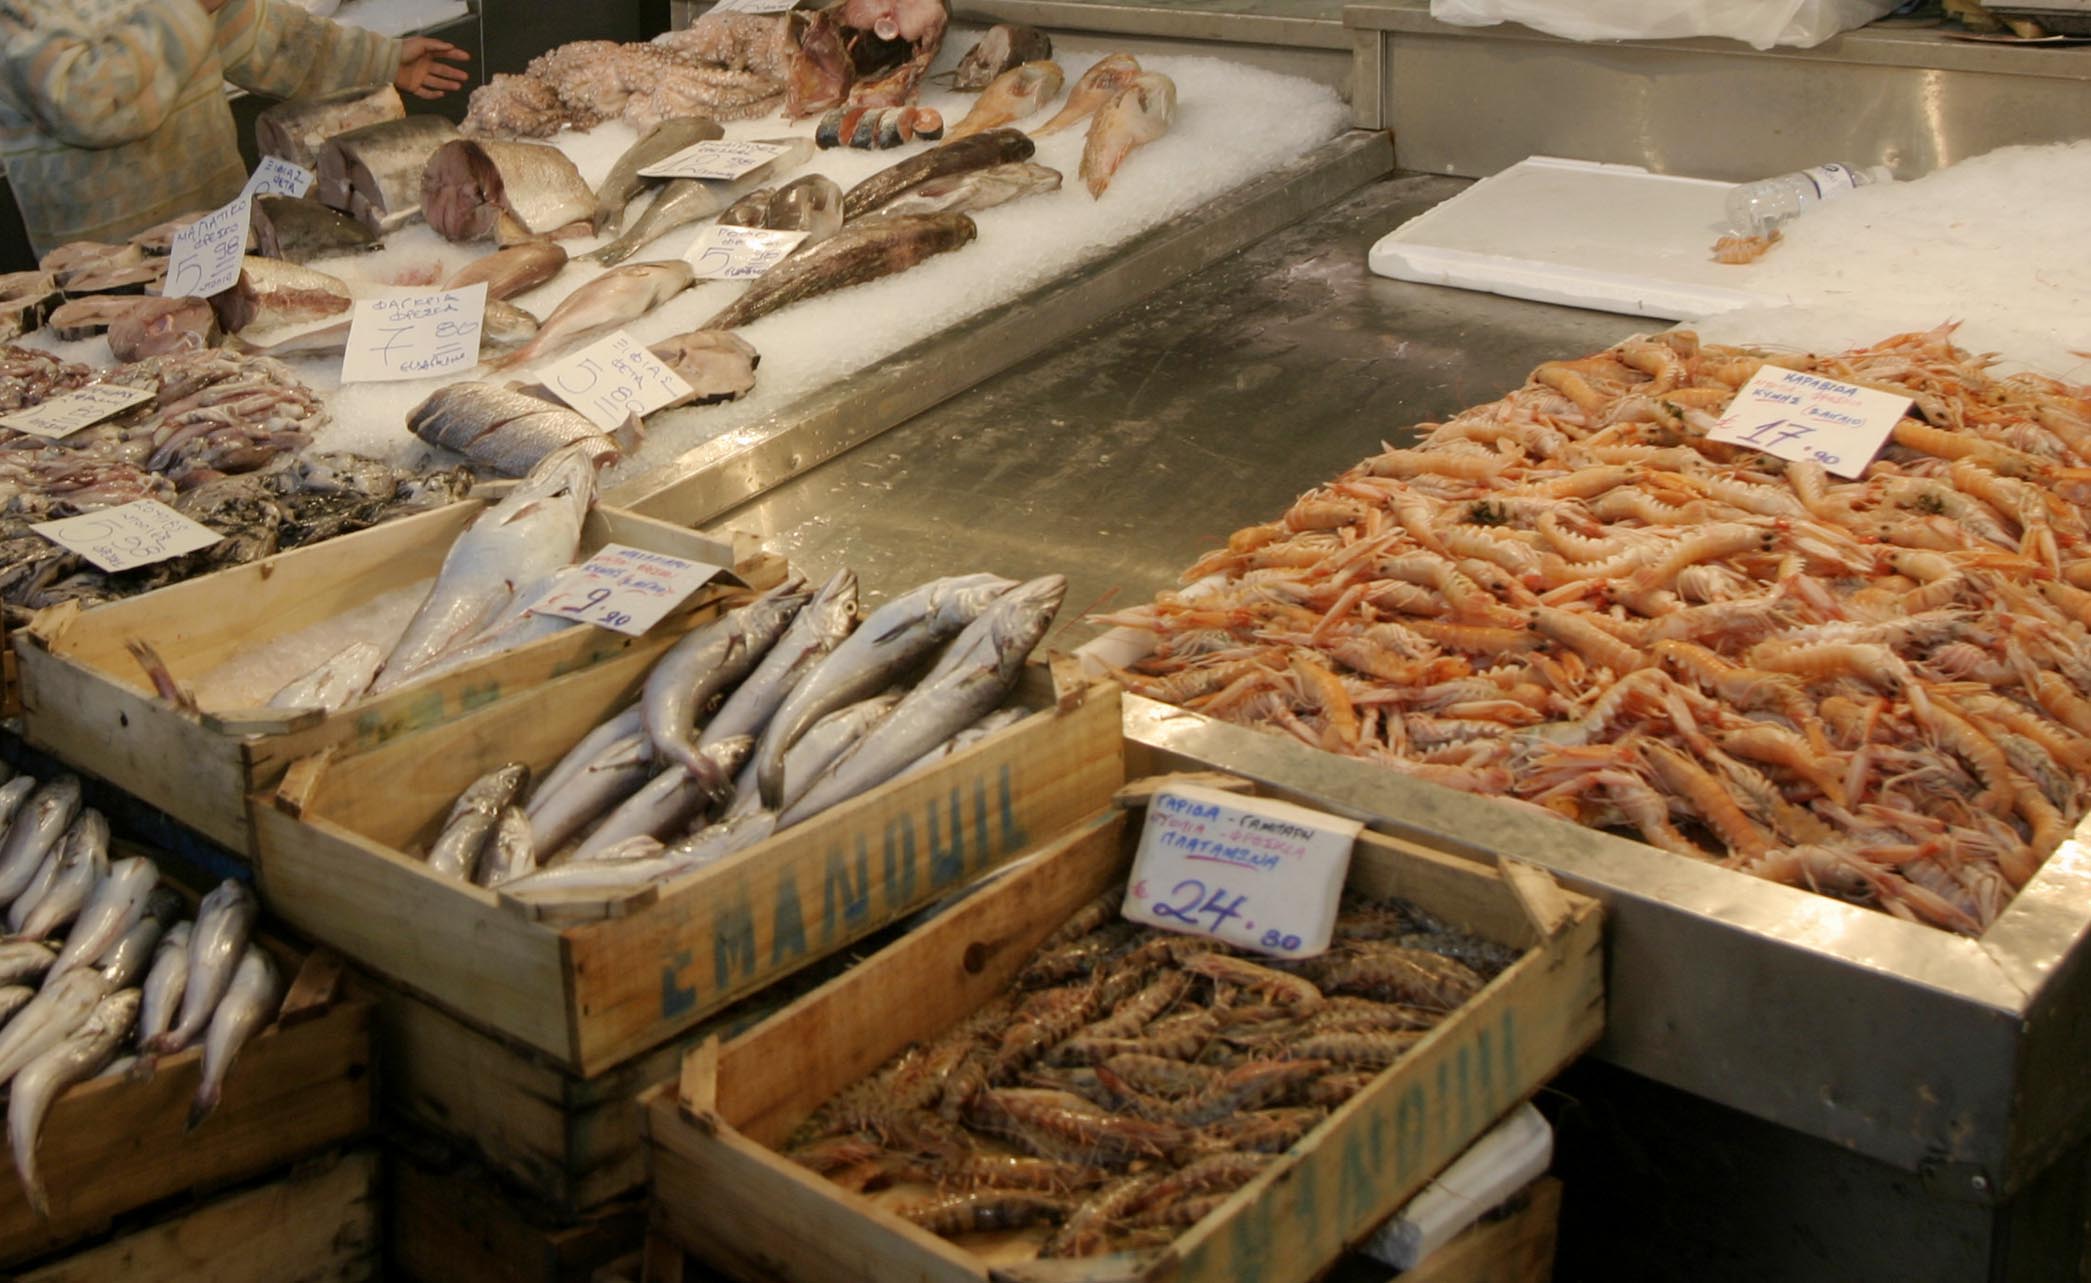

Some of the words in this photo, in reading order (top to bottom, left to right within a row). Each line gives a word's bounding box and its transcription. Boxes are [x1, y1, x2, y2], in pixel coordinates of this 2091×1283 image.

[175, 253, 203, 297] 5
[699, 246, 736, 278] 5
[368, 324, 416, 368] 7
[556, 357, 605, 394] 5
[1783, 373, 1858, 397] ΚΑΡΑΒΙΔΑ
[1155, 792, 1221, 821] ΓΑΡΙΔΑ
